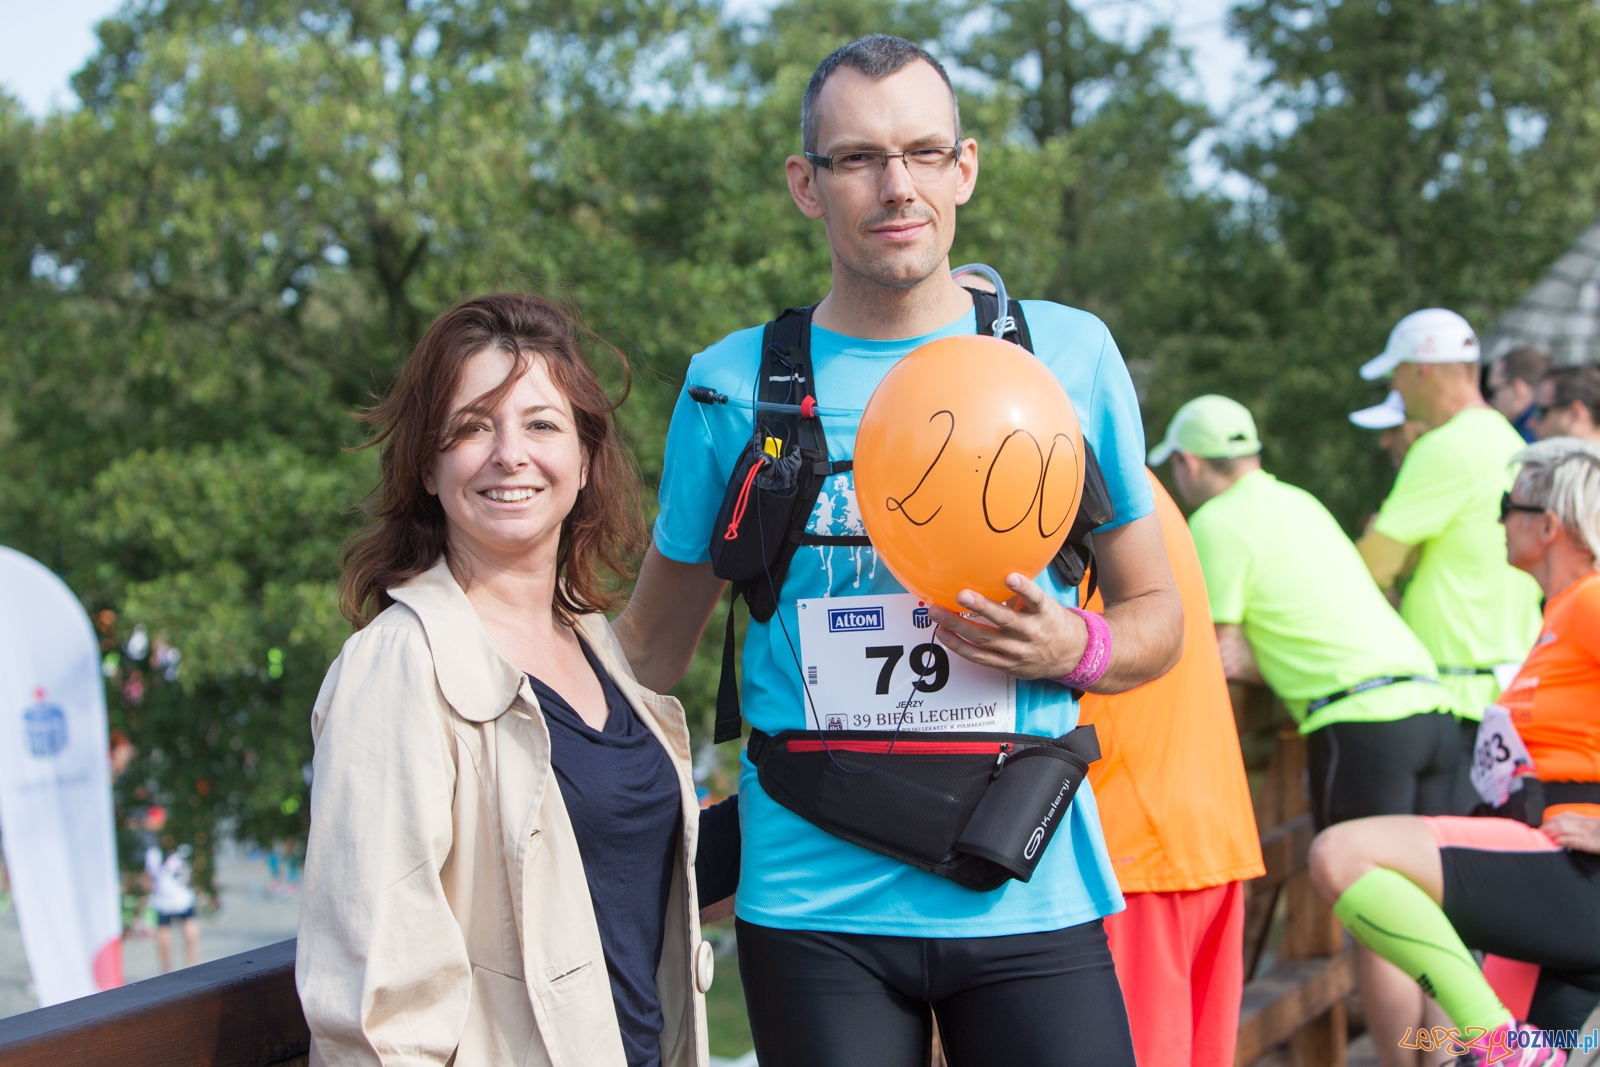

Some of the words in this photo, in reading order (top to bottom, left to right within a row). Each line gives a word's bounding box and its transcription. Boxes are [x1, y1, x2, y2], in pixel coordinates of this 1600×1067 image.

[885, 409, 1079, 539] 2:00
[865, 643, 950, 695] 79
[853, 713, 872, 728] 39
[876, 712, 915, 726] BIEG
[919, 702, 998, 723] LECHITÓW
[896, 700, 924, 708] JERZY
[1041, 779, 1070, 827] Kalenji
